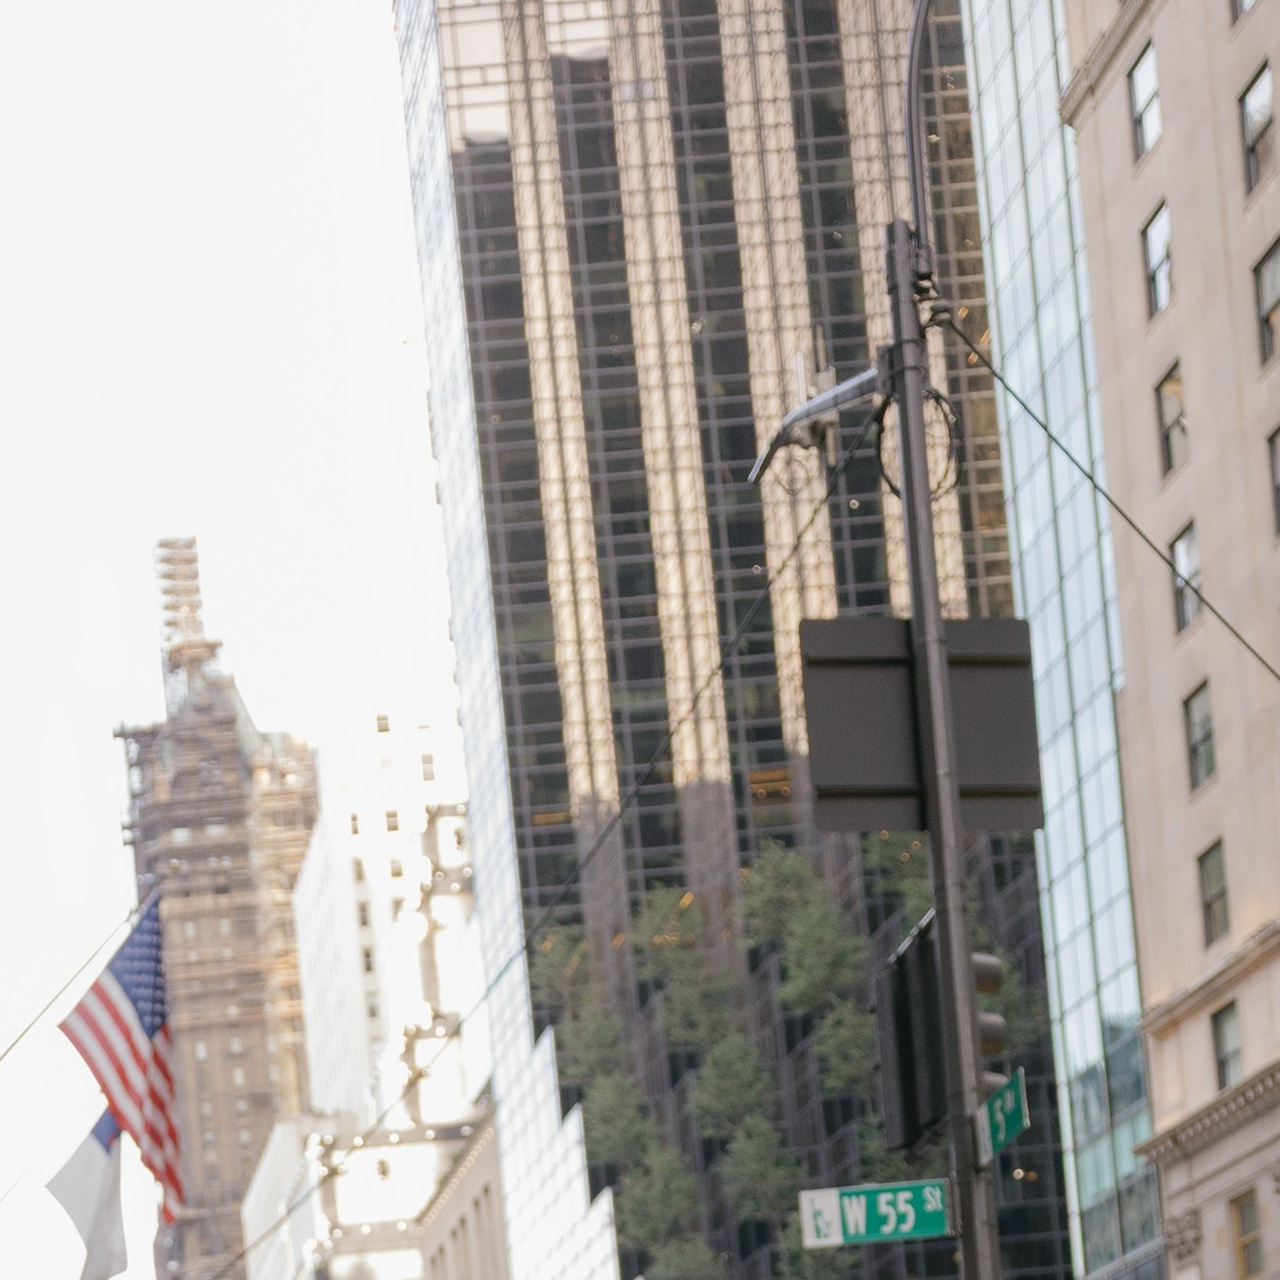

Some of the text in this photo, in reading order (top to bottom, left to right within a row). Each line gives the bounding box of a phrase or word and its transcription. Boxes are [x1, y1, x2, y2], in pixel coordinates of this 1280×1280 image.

[992, 1097, 1006, 1142] 5
[842, 1185, 943, 1236] W 55 St
